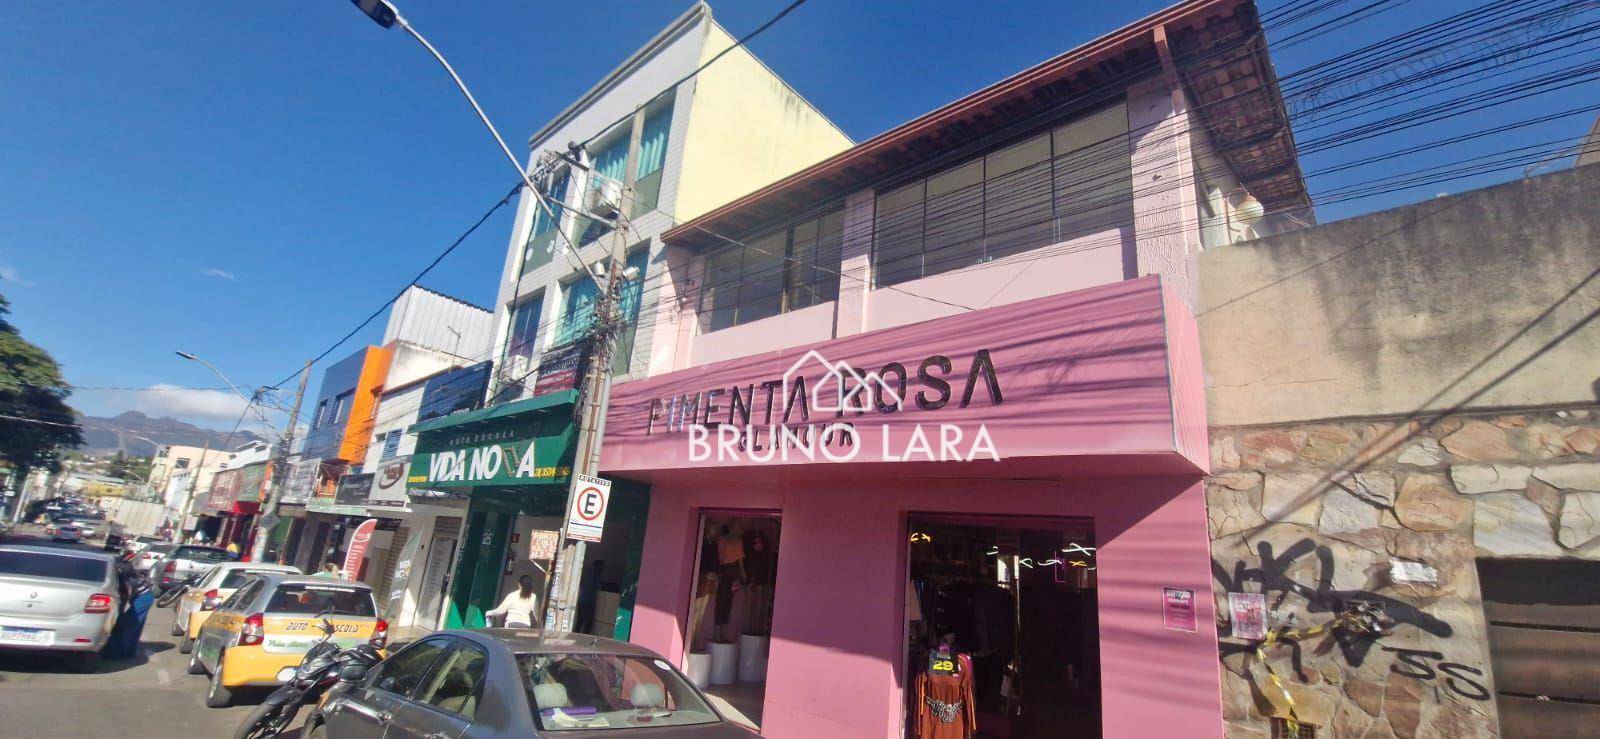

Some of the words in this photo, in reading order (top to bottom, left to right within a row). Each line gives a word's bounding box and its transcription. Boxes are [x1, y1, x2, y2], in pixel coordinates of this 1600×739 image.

[646, 375, 810, 436] PIMENTA
[836, 348, 1004, 418] ROSA
[428, 449, 466, 482] VIDA
[584, 493, 597, 515] E
[286, 622, 308, 631] AUTO
[334, 624, 359, 633] SCOLA
